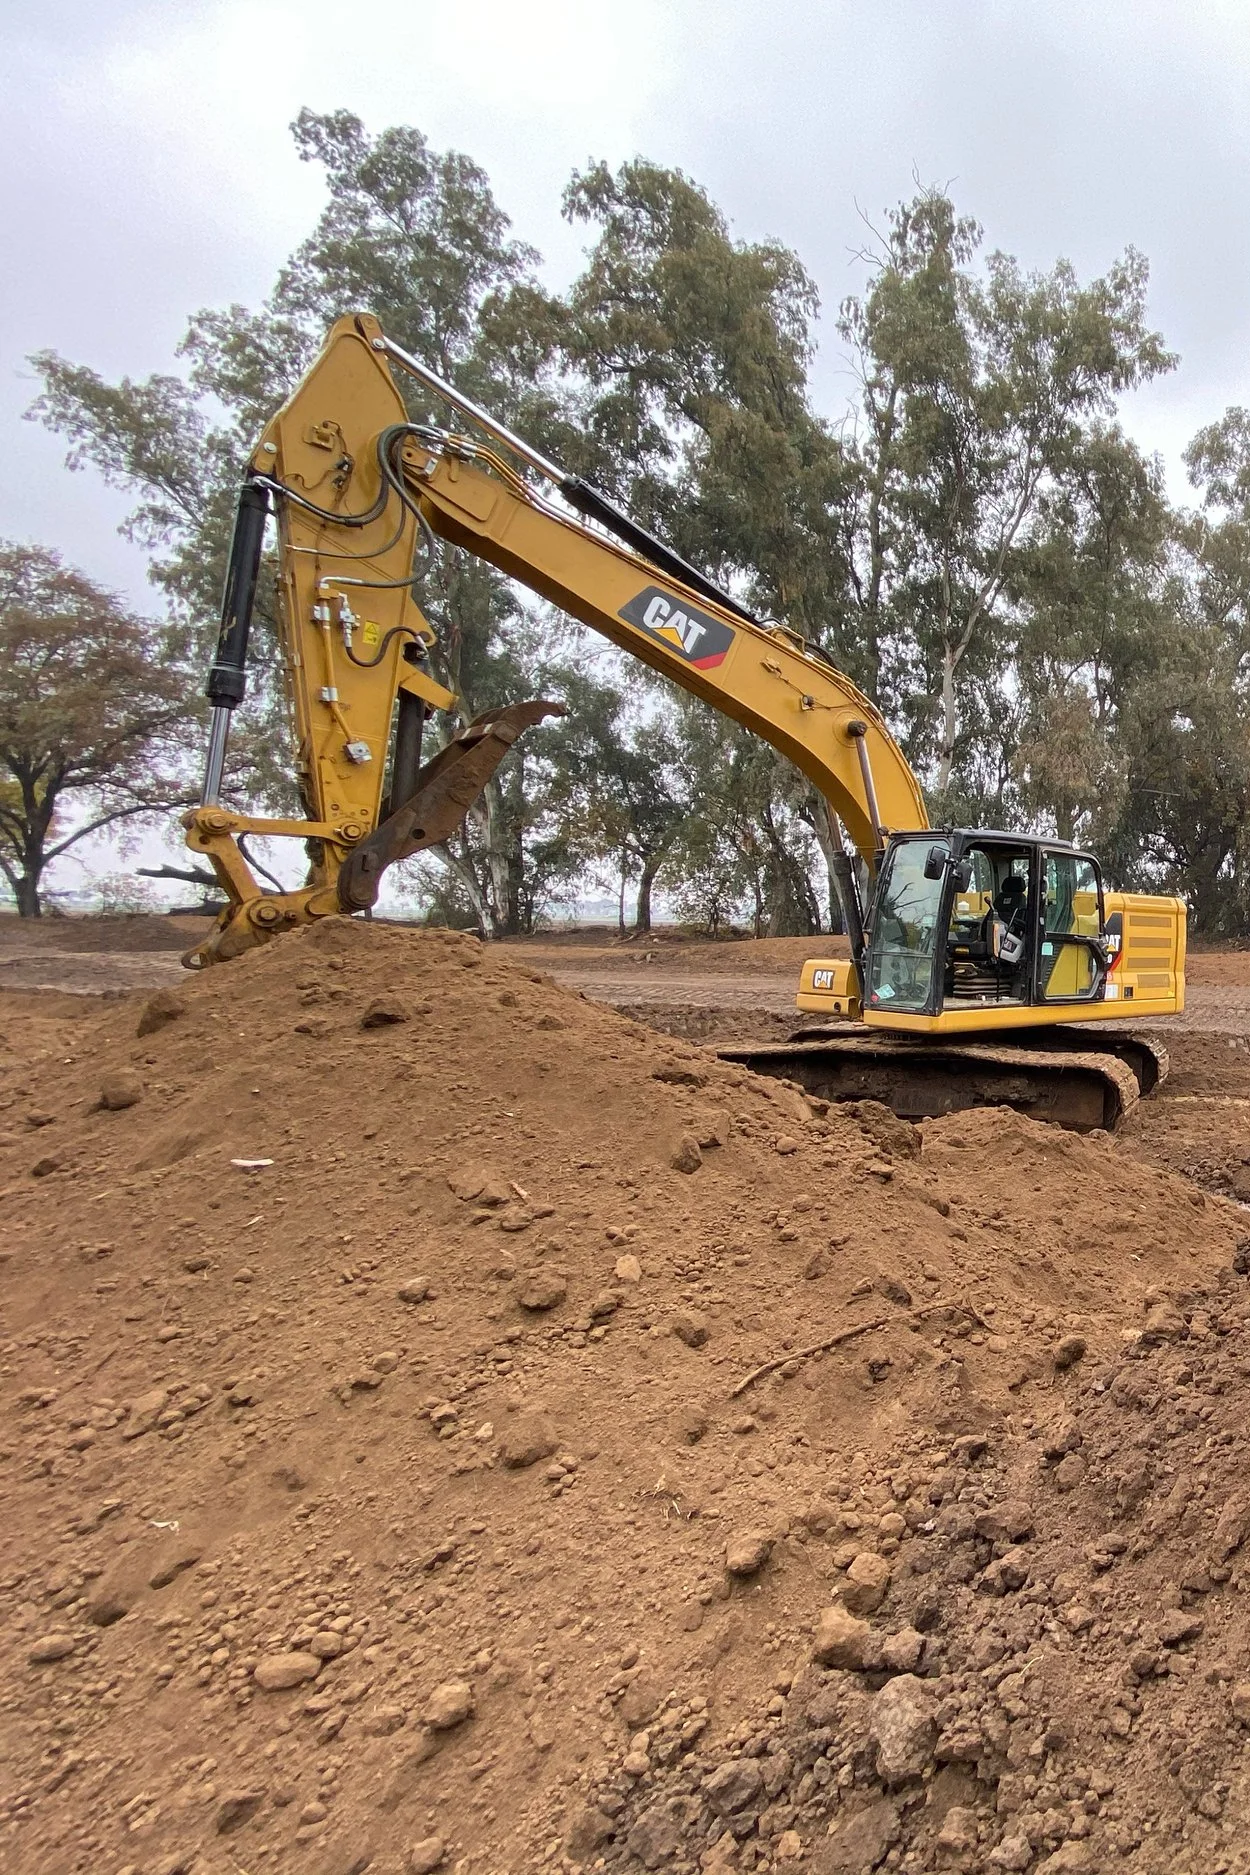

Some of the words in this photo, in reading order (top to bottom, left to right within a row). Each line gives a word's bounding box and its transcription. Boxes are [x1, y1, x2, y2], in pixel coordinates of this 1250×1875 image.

[643, 596, 707, 654] CAT
[1105, 934, 1121, 952] AT
[814, 970, 834, 989] CAT
